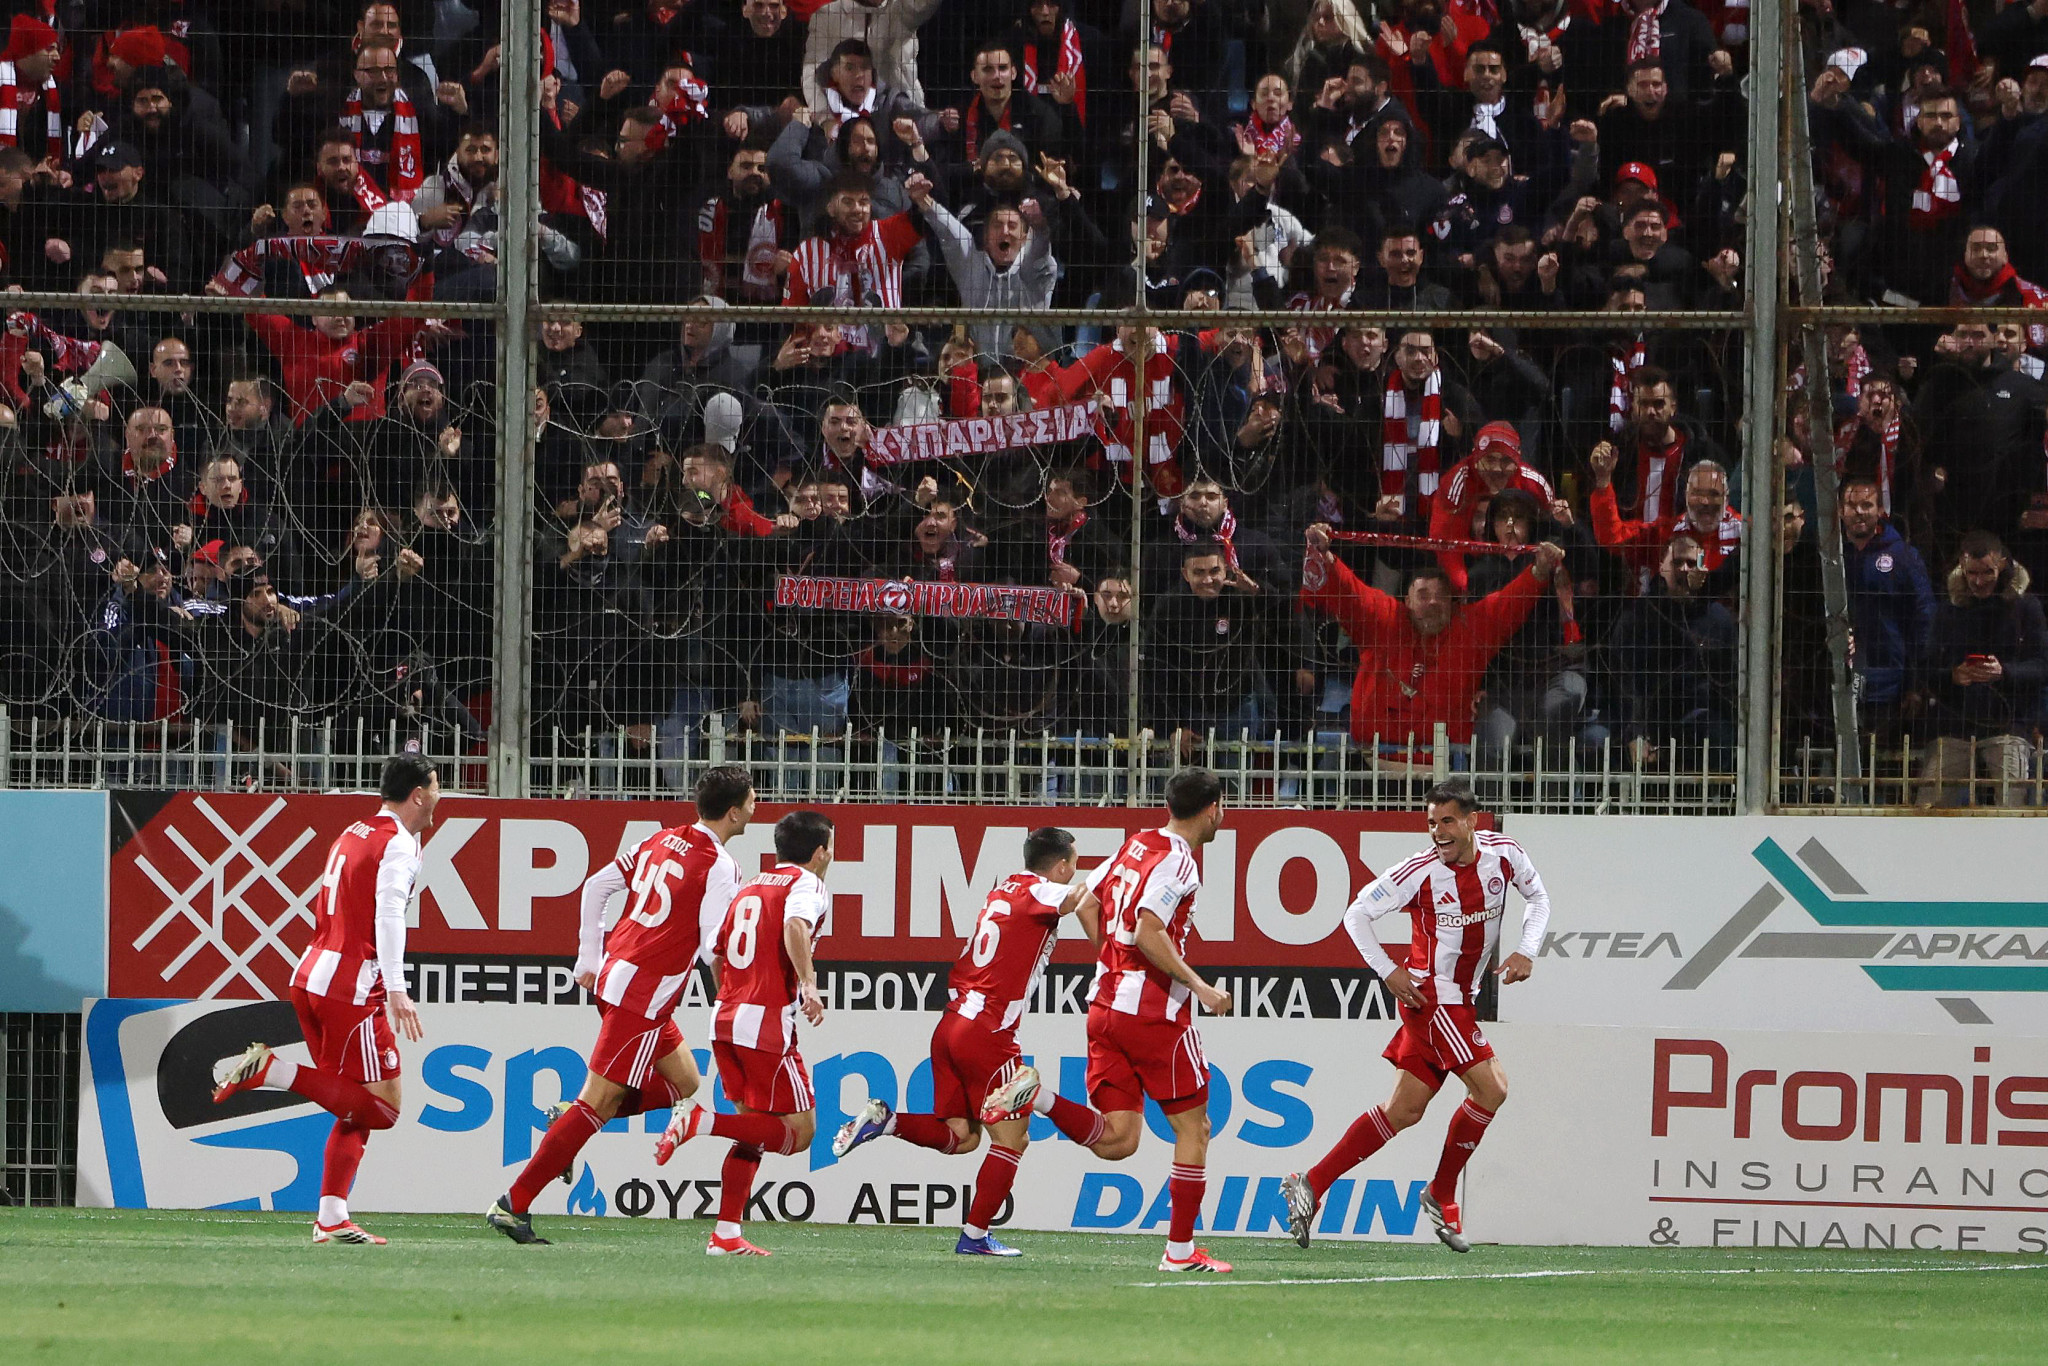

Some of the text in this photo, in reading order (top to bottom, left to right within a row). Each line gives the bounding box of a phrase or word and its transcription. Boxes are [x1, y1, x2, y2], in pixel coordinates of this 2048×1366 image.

[777, 577, 877, 612] ΒΟΡΕΙΑ
[322, 843, 346, 916] 4
[629, 849, 685, 928] 45
[727, 895, 762, 970] 8
[1437, 904, 1502, 928] Stoiximan
[1538, 931, 1683, 959] ΚΤΕΛ
[1651, 1038, 2048, 1147] Promis
[614, 1178, 816, 1222] ΦΥΣΚΟ
[1649, 1217, 1681, 1246] &
[1713, 1219, 1987, 1251] FINANCE
